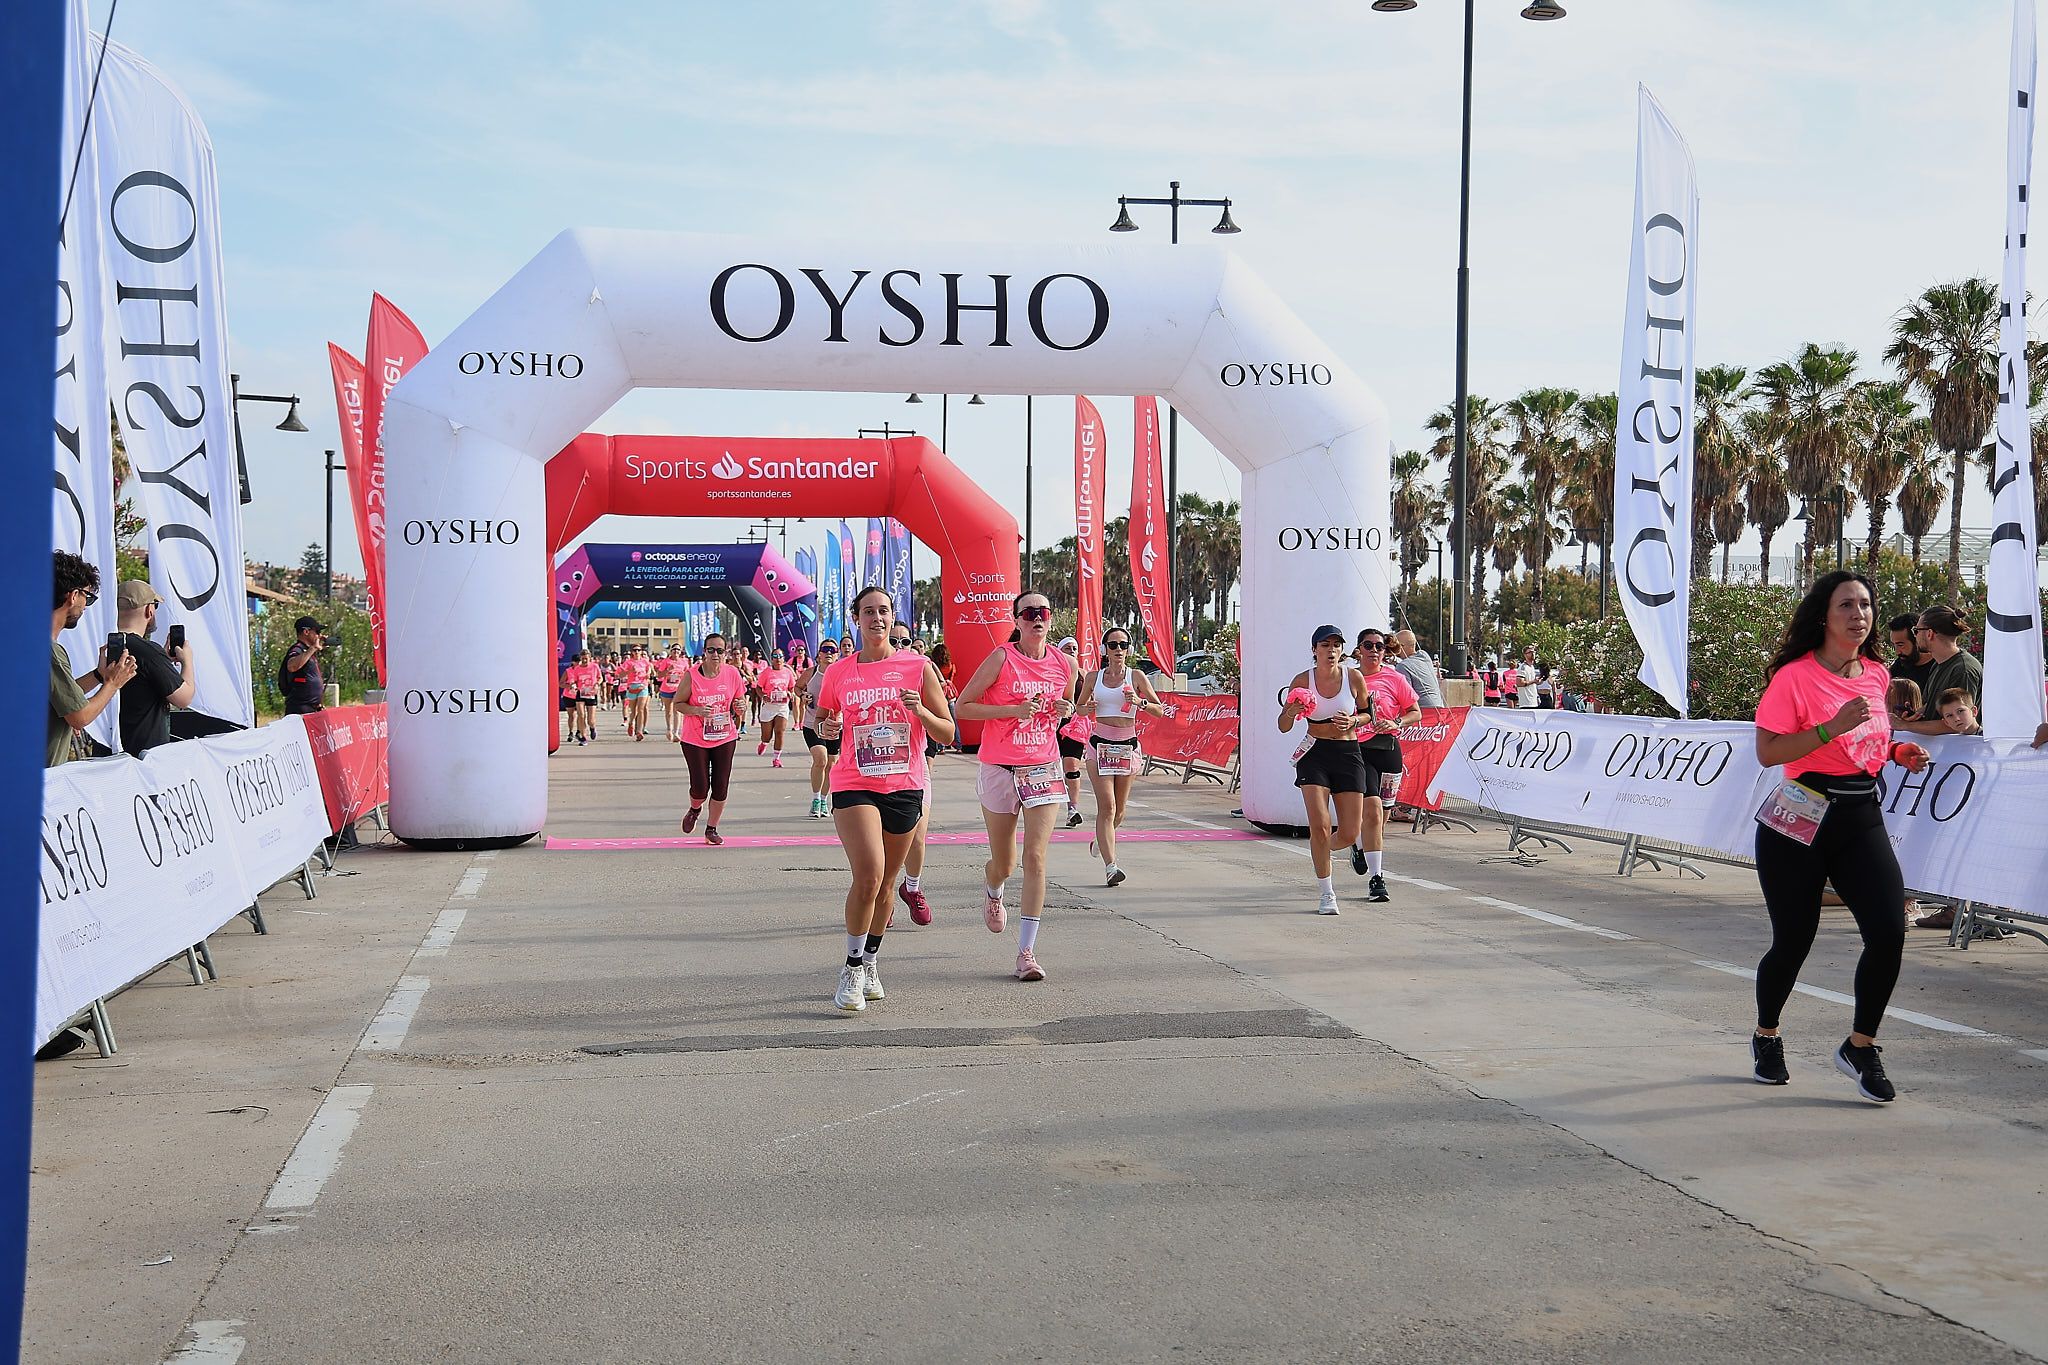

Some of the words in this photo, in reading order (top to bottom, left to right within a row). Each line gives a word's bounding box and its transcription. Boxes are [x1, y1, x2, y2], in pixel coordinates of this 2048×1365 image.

[709, 263, 1110, 351] OYSHO
[458, 351, 584, 379] OYSHO
[1220, 362, 1332, 387] OYSHO
[625, 454, 707, 485] Sports
[748, 457, 879, 479] Santander
[707, 489, 792, 500] sportssantander.es
[403, 519, 520, 546] OYSHO
[1278, 526, 1381, 551] OYSHO
[637, 565, 670, 573] ENERGÍA
[645, 552, 687, 563] octopus
[687, 553, 722, 564] energy
[969, 572, 1005, 586] Sports
[846, 687, 898, 706] CARRERA
[1012, 681, 1056, 694] CARRERA
[403, 688, 519, 715] OYSHO
[1012, 730, 1048, 745] MUJER
[1468, 727, 1572, 772] OYSHO
[873, 746, 896, 756] 016
[1604, 733, 1733, 787] OYSHO
[226, 753, 284, 824] OYSHO
[1032, 781, 1051, 791] 016
[133, 778, 214, 868] OYSHO
[1773, 805, 1797, 824] 016
